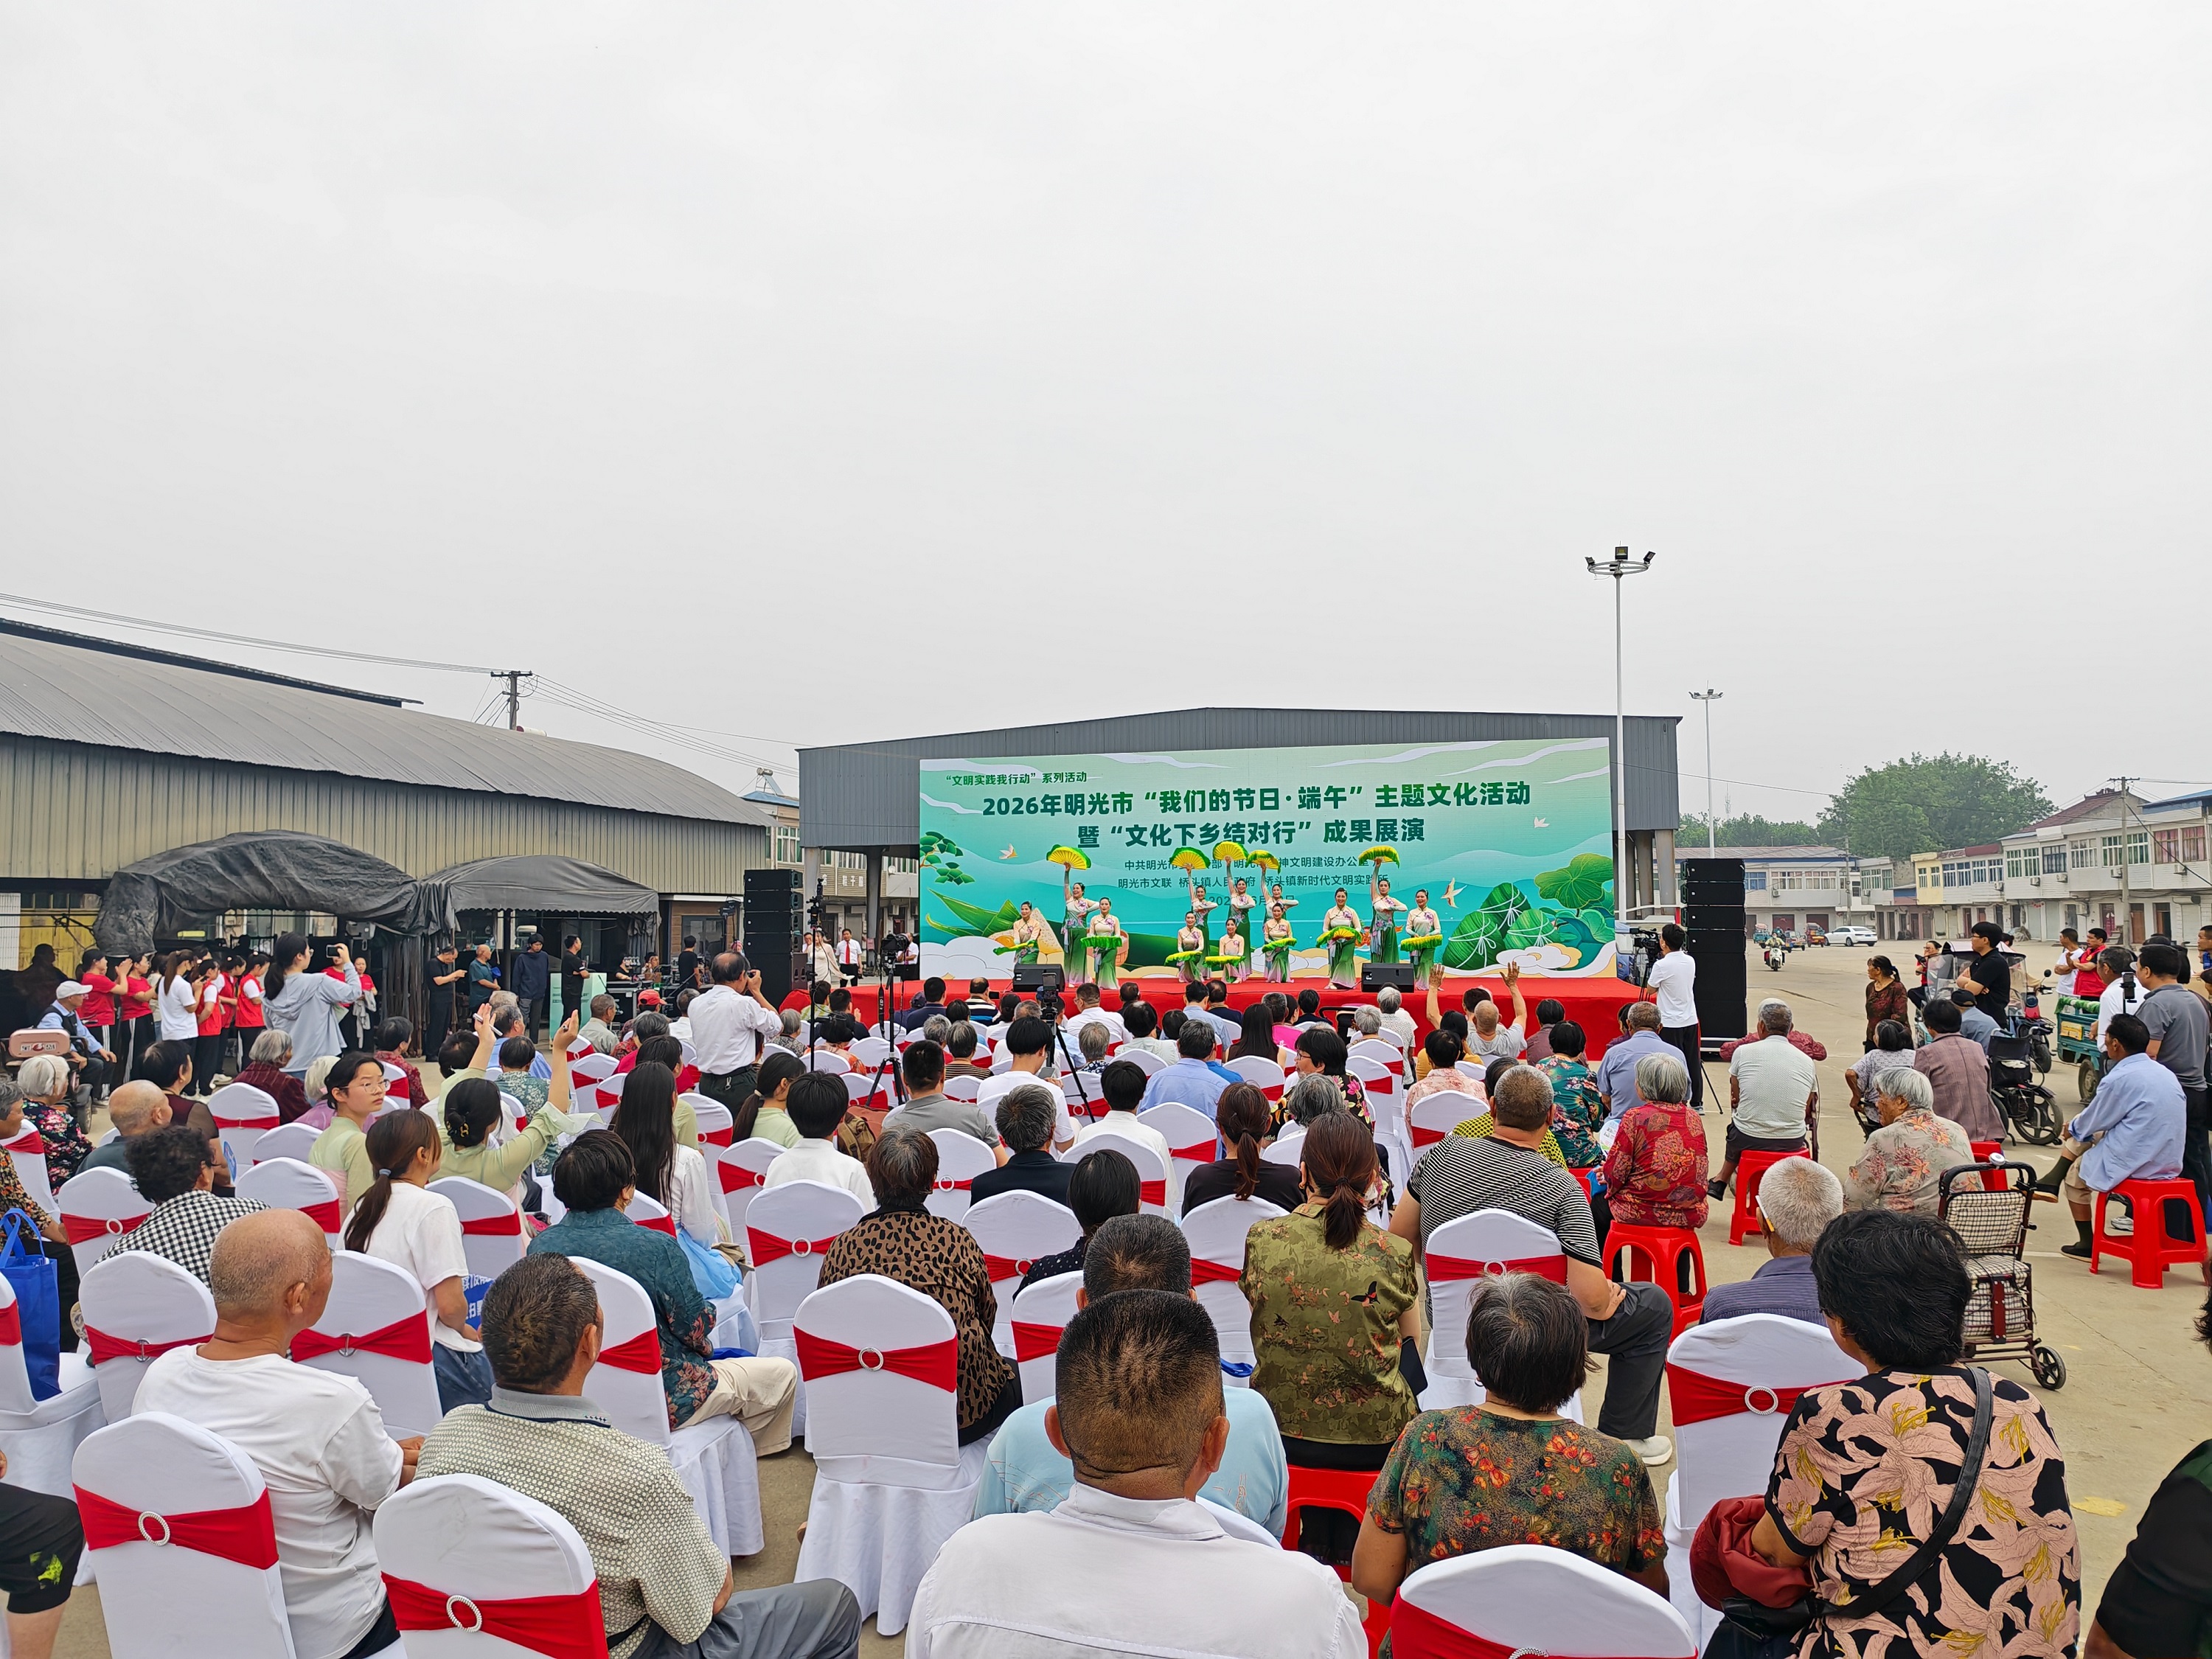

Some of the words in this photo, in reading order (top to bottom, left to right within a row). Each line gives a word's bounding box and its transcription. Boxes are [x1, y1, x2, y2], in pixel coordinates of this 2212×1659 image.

[1118, 877, 1172, 889] 明光市文联
